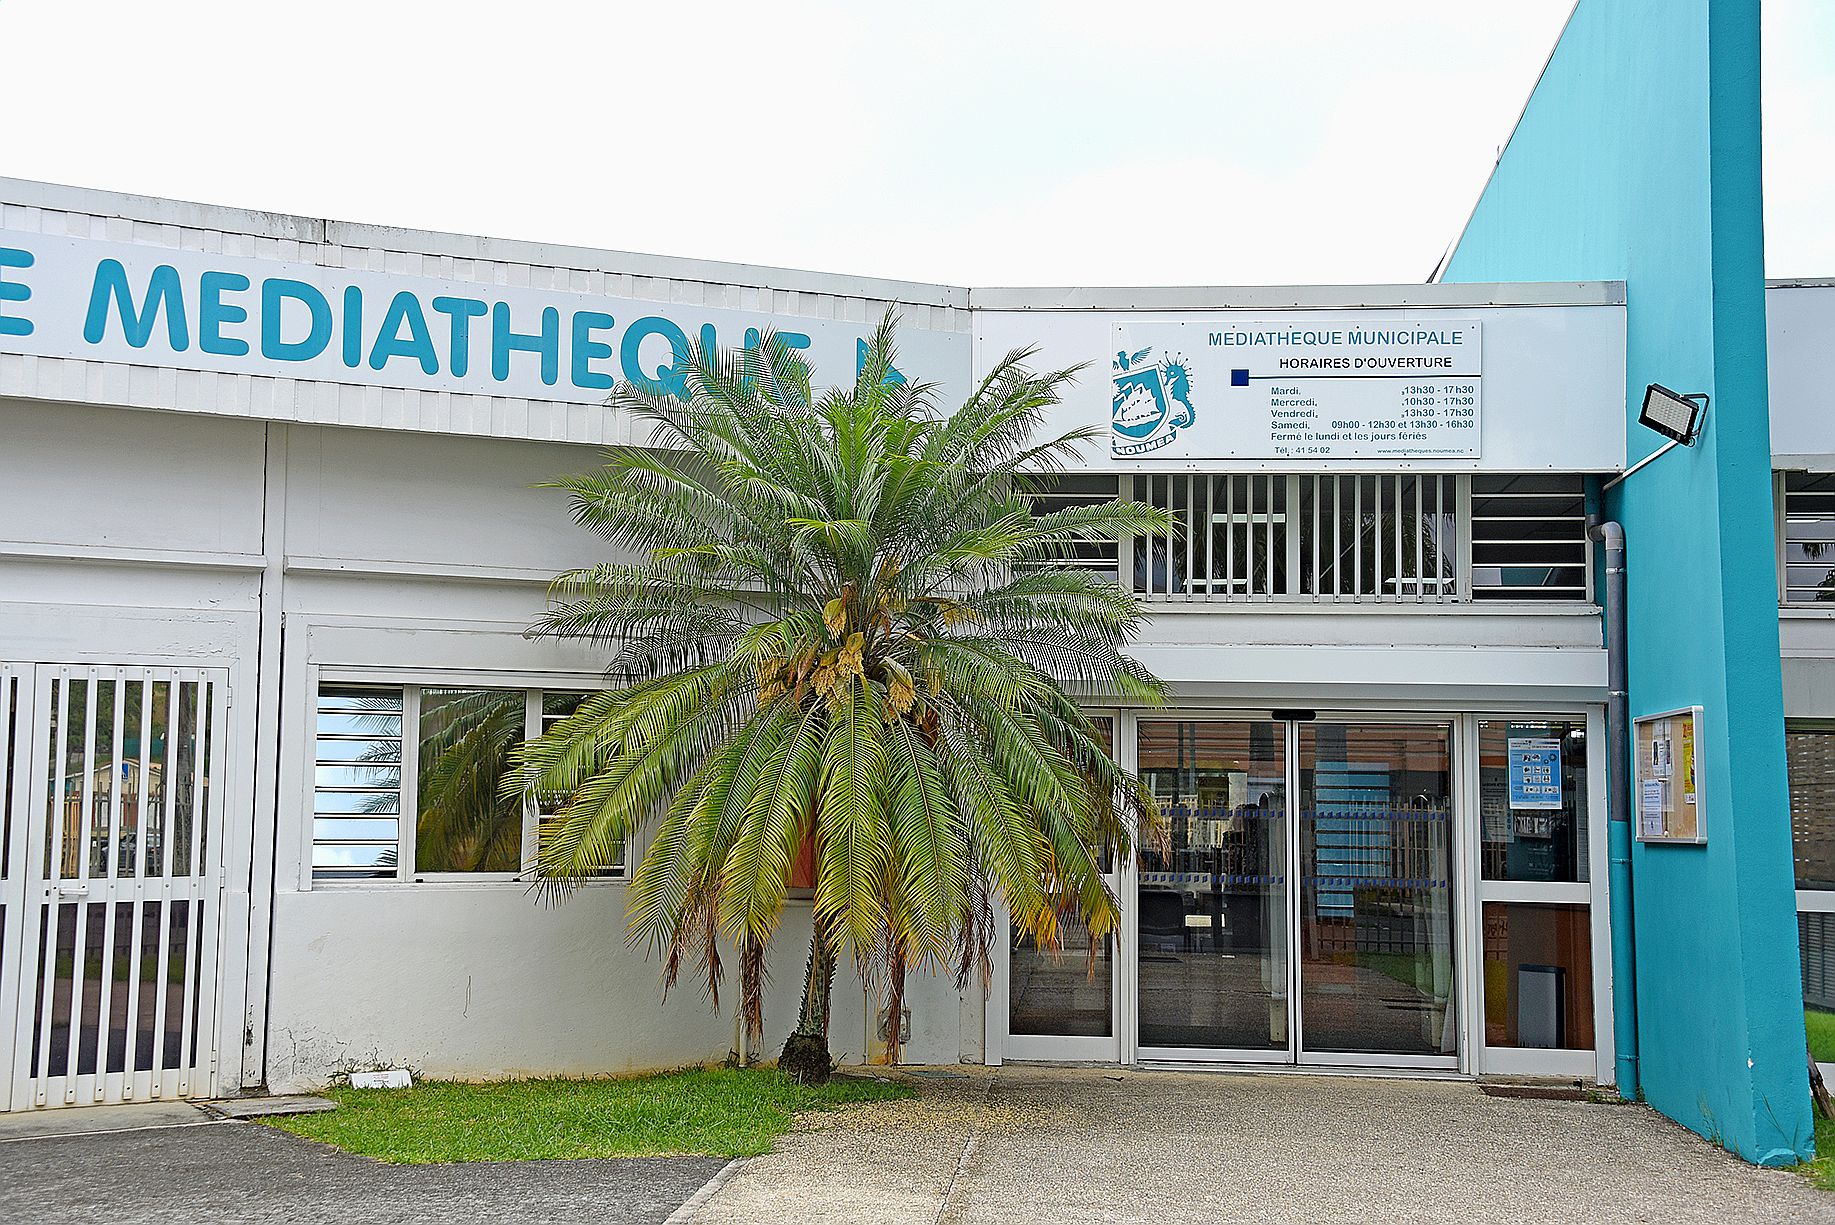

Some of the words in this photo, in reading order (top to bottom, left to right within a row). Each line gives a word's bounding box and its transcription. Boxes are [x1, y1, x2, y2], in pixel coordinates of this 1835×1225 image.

[1208, 331, 1343, 347] MEDIATHEQUE
[1348, 330, 1463, 346] MUNICIPALE
[1279, 357, 1351, 369] HORAIRES
[1354, 356, 1453, 369] D'OUVERTURE
[1443, 396, 1475, 406] 17h30
[1443, 408, 1475, 417] 17h30
[1331, 420, 1360, 429] 09h00
[1367, 420, 1396, 429] 12h30
[1397, 420, 1408, 429] et
[1409, 419, 1438, 429] 13h30
[1445, 419, 1475, 429] 16h30
[1270, 432, 1302, 441] Fermé
[1304, 432, 1314, 441] le
[1315, 432, 1340, 441] lundi
[1342, 432, 1353, 441] et
[1354, 432, 1369, 441] les
[1370, 431, 1397, 443] jours
[1115, 434, 1175, 455] NOUMEA
[1295, 446, 1305, 454] 41
[1307, 446, 1318, 454] 54
[1319, 446, 1331, 454] 02
